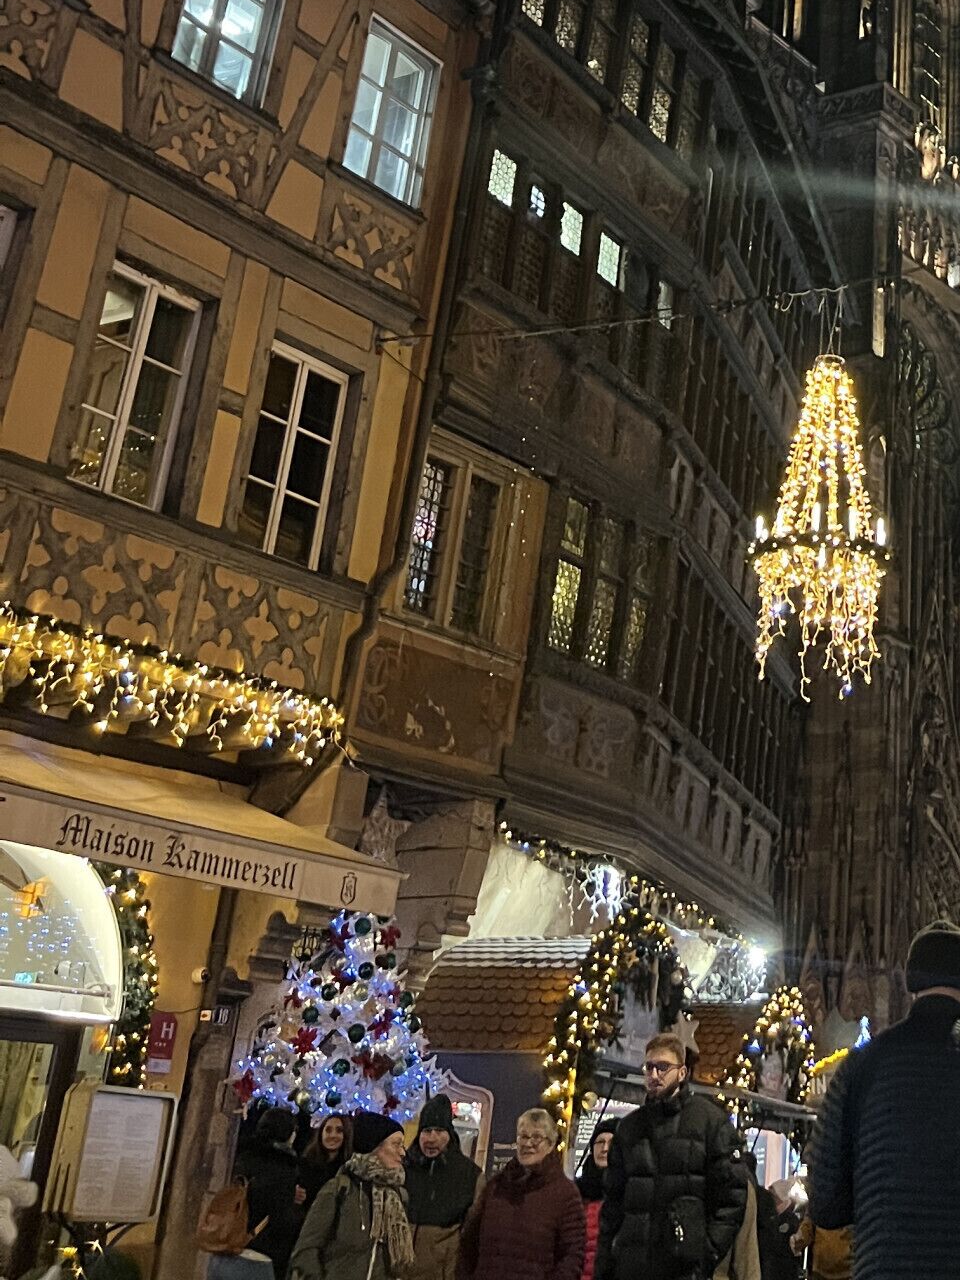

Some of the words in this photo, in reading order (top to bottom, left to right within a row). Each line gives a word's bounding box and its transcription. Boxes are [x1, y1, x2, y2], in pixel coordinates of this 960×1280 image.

[55, 813, 155, 864] Maison
[162, 834, 297, 891] Kammerzell
[160, 1021, 176, 1040] H
